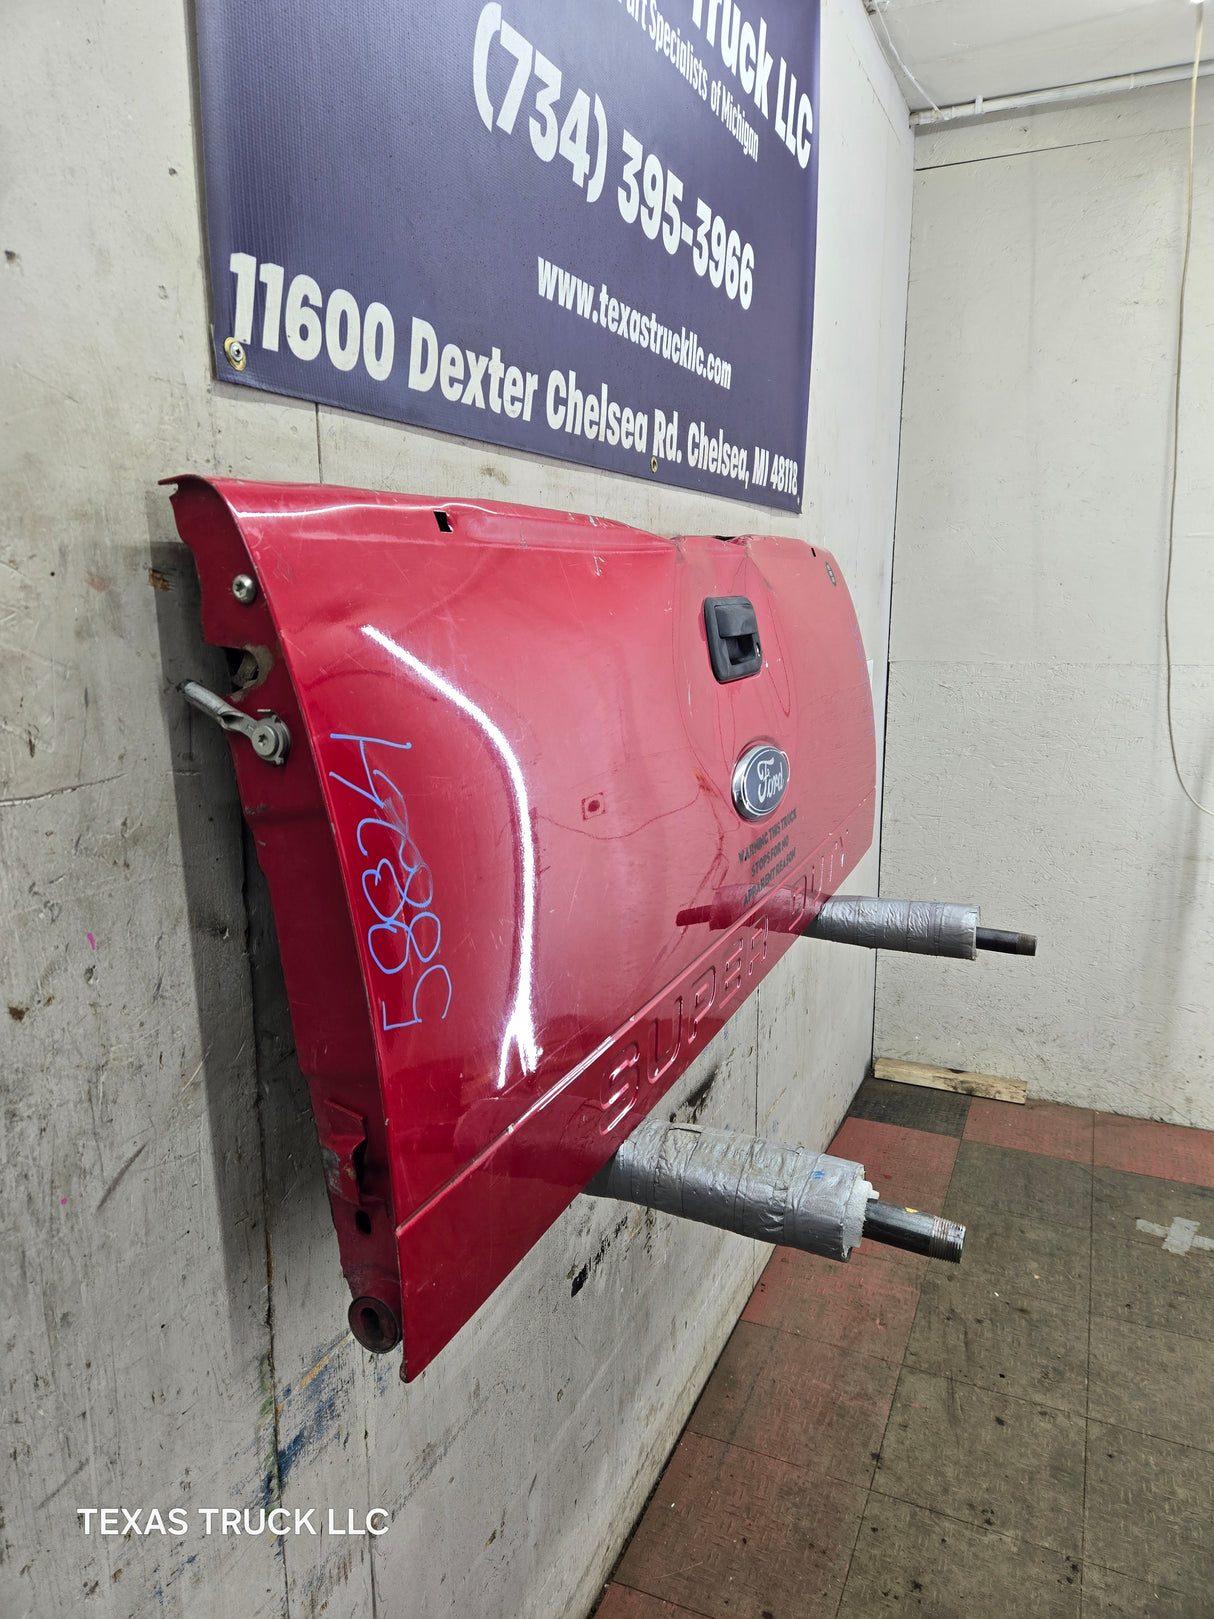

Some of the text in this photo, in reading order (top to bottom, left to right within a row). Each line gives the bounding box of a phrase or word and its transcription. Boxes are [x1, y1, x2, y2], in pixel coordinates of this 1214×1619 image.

[473, 1, 755, 310] (734) 395-3966
[649, 0, 708, 101] Specialists
[711, 80, 722, 116] of
[721, 85, 759, 163] Michigan
[692, 0, 813, 169] ruck LLC
[230, 252, 798, 495] 11600 Dexter Chelsea Rd. Chelsea, MI 48118
[538, 256, 732, 390] www.texastruckllc.com
[738, 808, 797, 864] WARNING THIS TRUCK
[757, 757, 784, 803] Ford
[743, 847, 796, 907] APPARENT REASON
[751, 834, 789, 878] STOPS FOR NO
[600, 913, 769, 1136] SUPER
